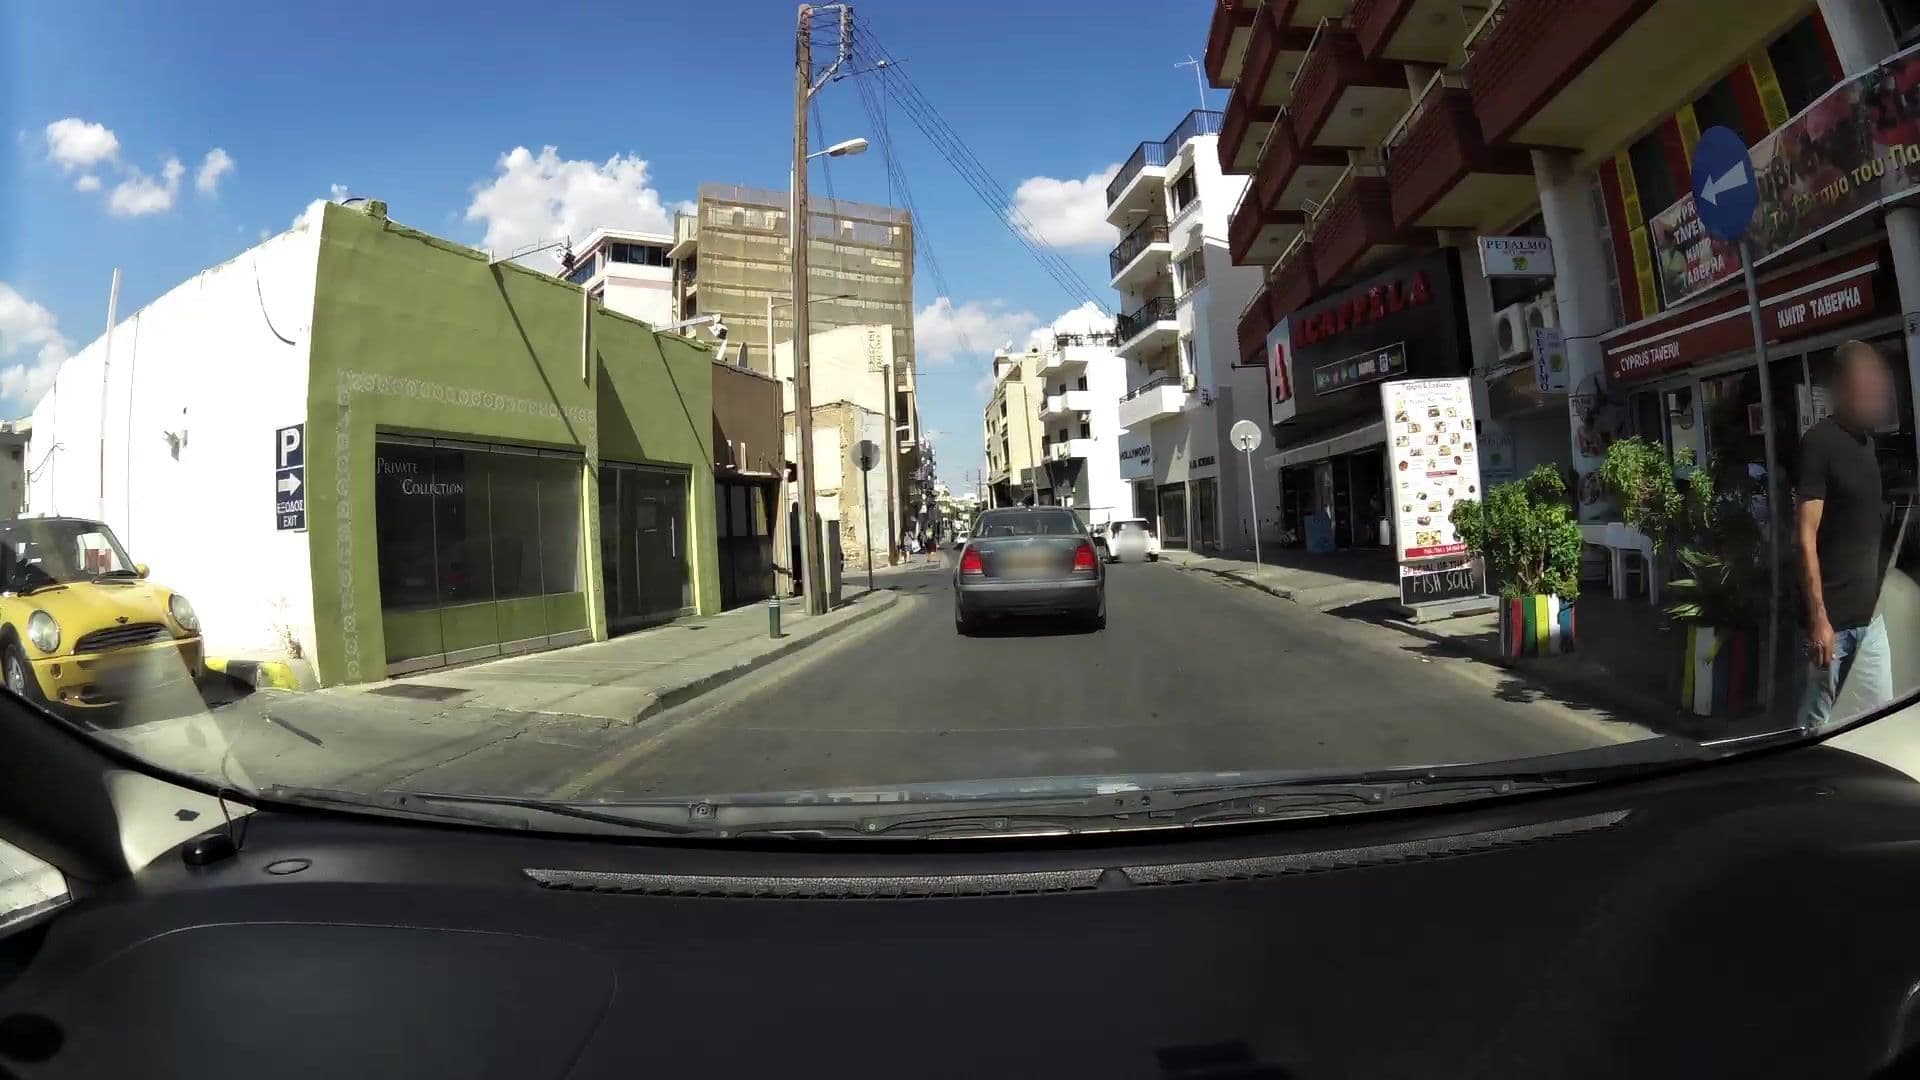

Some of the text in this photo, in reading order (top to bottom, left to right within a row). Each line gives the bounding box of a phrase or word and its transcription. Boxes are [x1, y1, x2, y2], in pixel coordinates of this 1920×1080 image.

[1673, 216, 1706, 245] TAVER
[1486, 240, 1547, 250] PETALMO
[1777, 287, 1862, 328] КИПР ТАВЕРНА
[1620, 351, 1649, 372] CYPRUS
[281, 428, 300, 467] P
[277, 500, 304, 514] ΕΞΟΔΟΣ
[283, 515, 298, 527] EXIT
[1413, 573, 1442, 593] FISH
